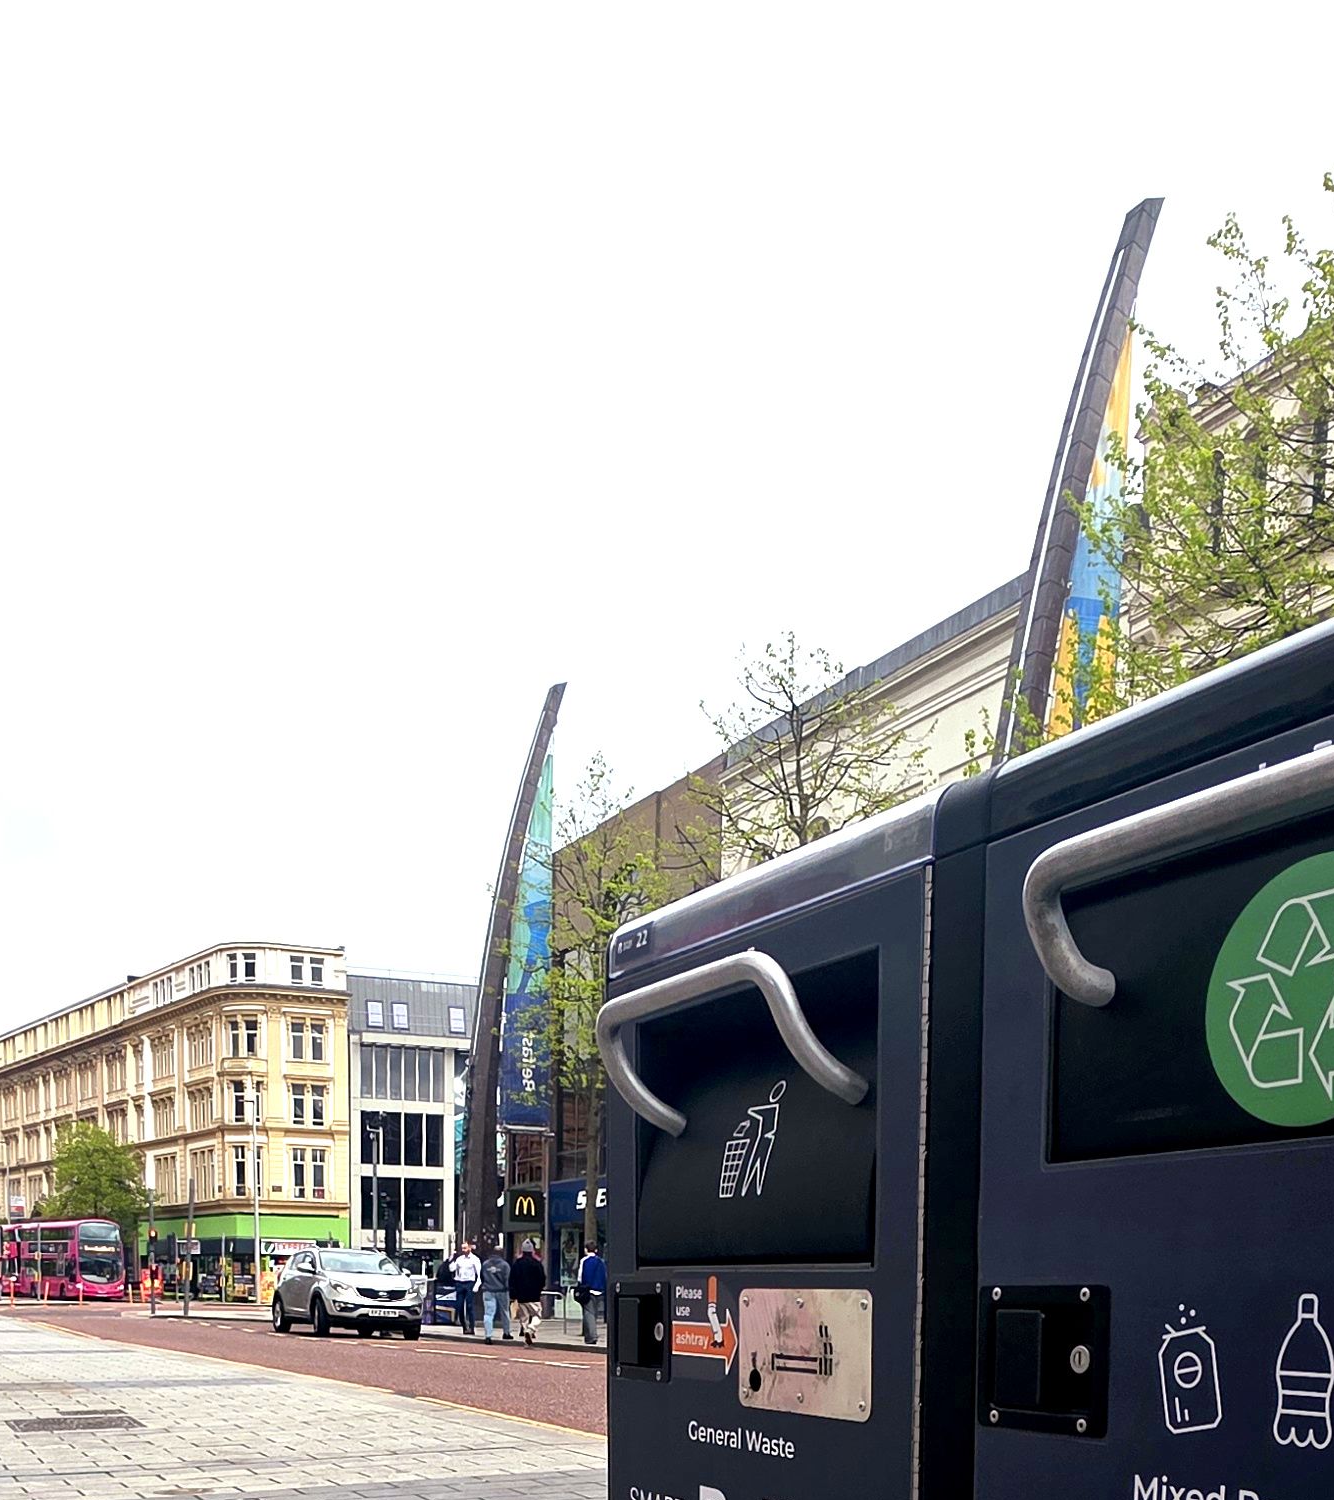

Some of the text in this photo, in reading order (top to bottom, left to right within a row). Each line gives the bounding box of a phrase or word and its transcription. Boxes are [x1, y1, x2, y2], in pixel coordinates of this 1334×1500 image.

[676, 1286, 703, 1300] Please
[676, 1306, 691, 1317] use
[675, 1333, 709, 1350] ashtray
[688, 1421, 796, 1459] General Waste
